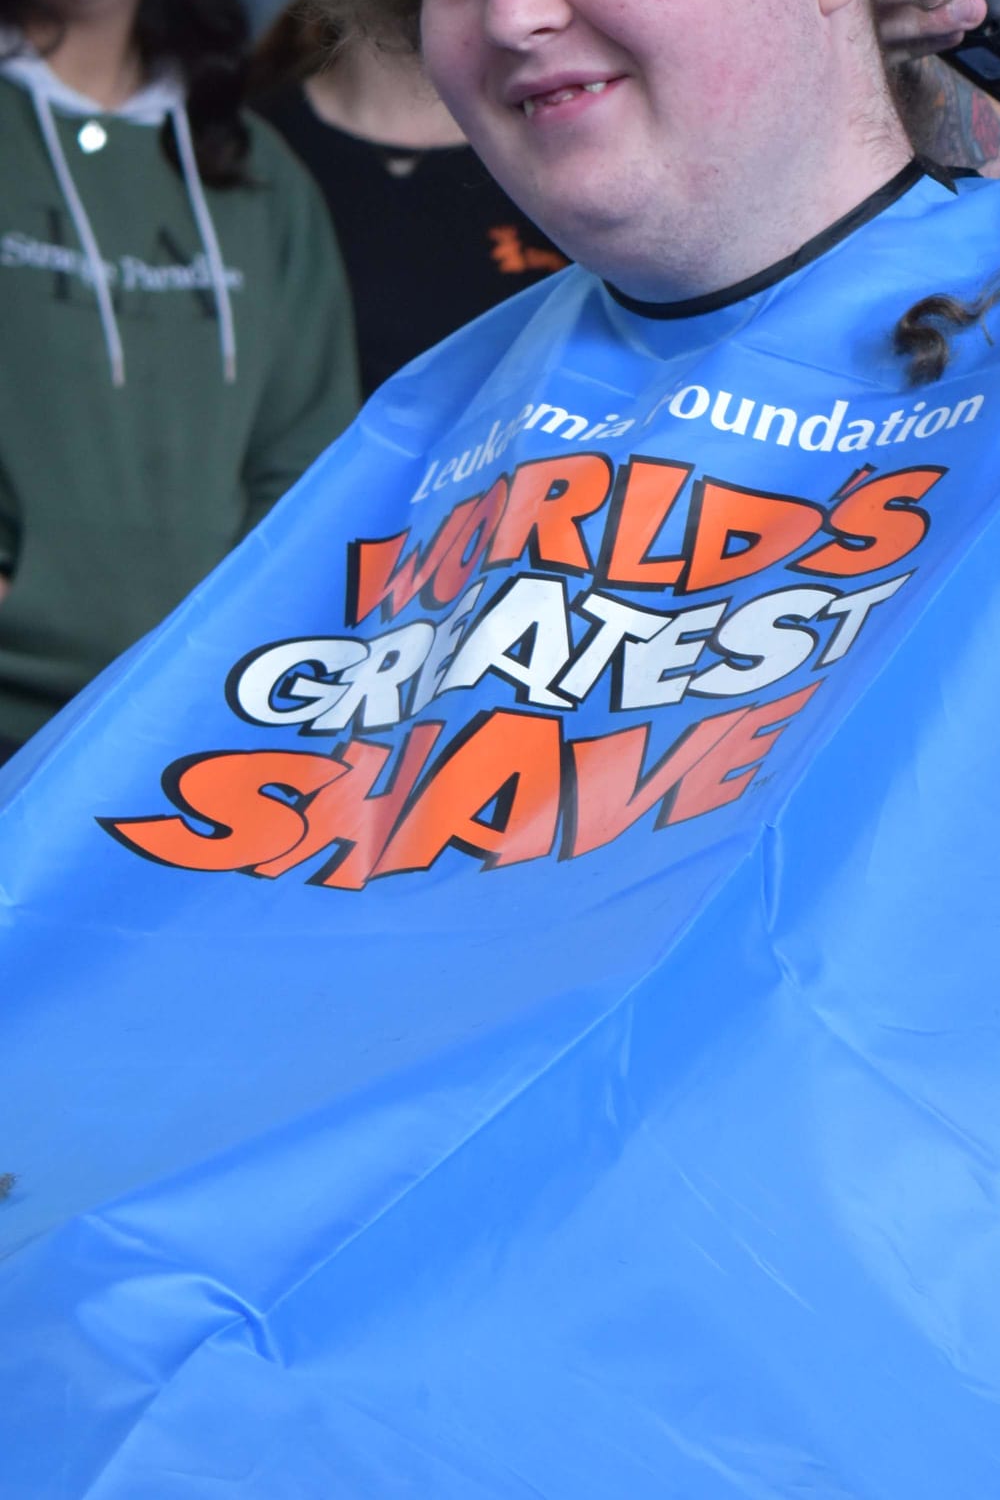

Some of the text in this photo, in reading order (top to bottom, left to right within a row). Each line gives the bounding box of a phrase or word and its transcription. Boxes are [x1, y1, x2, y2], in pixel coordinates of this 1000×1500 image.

[347, 451, 950, 629] WORLD'S
[224, 567, 919, 736] GREATEST
[95, 675, 828, 892] SHAVE
